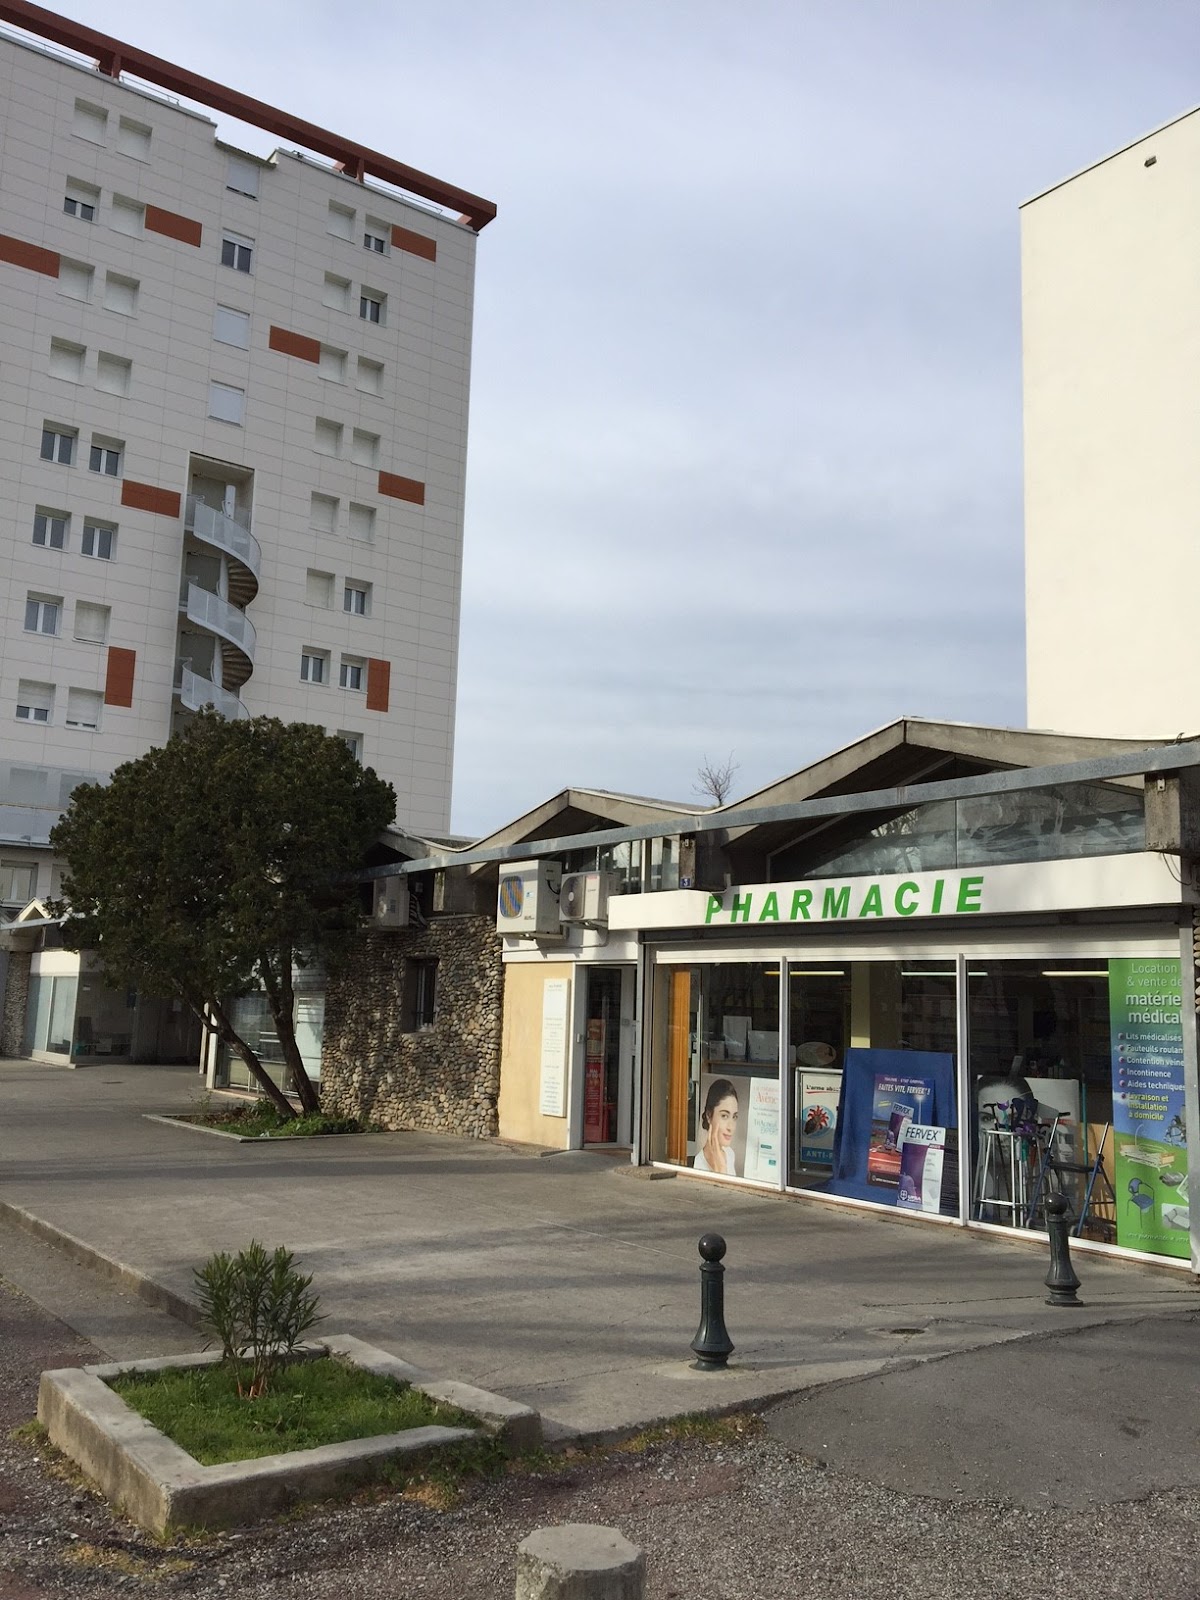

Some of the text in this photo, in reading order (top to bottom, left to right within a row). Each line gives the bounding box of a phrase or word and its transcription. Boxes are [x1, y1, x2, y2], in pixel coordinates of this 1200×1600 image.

[704, 876, 984, 924] PHARMACIE
[1131, 962, 1177, 974] Location
[1127, 976, 1135, 987] &
[1138, 977, 1168, 987] vente
[1125, 990, 1182, 1006] matérie
[1128, 1008, 1183, 1024] médical
[1125, 1032, 1182, 1042] Lits médicalisés
[1126, 1044, 1184, 1054] Fauteuils roulan
[1126, 1056, 1184, 1067] Contention veine
[1126, 1068, 1172, 1079] Incontinence
[878, 1083, 894, 1092] FAITES
[1127, 1080, 1147, 1088] Aides
[1128, 1092, 1160, 1102] Livraison
[1134, 1111, 1165, 1121] domicile
